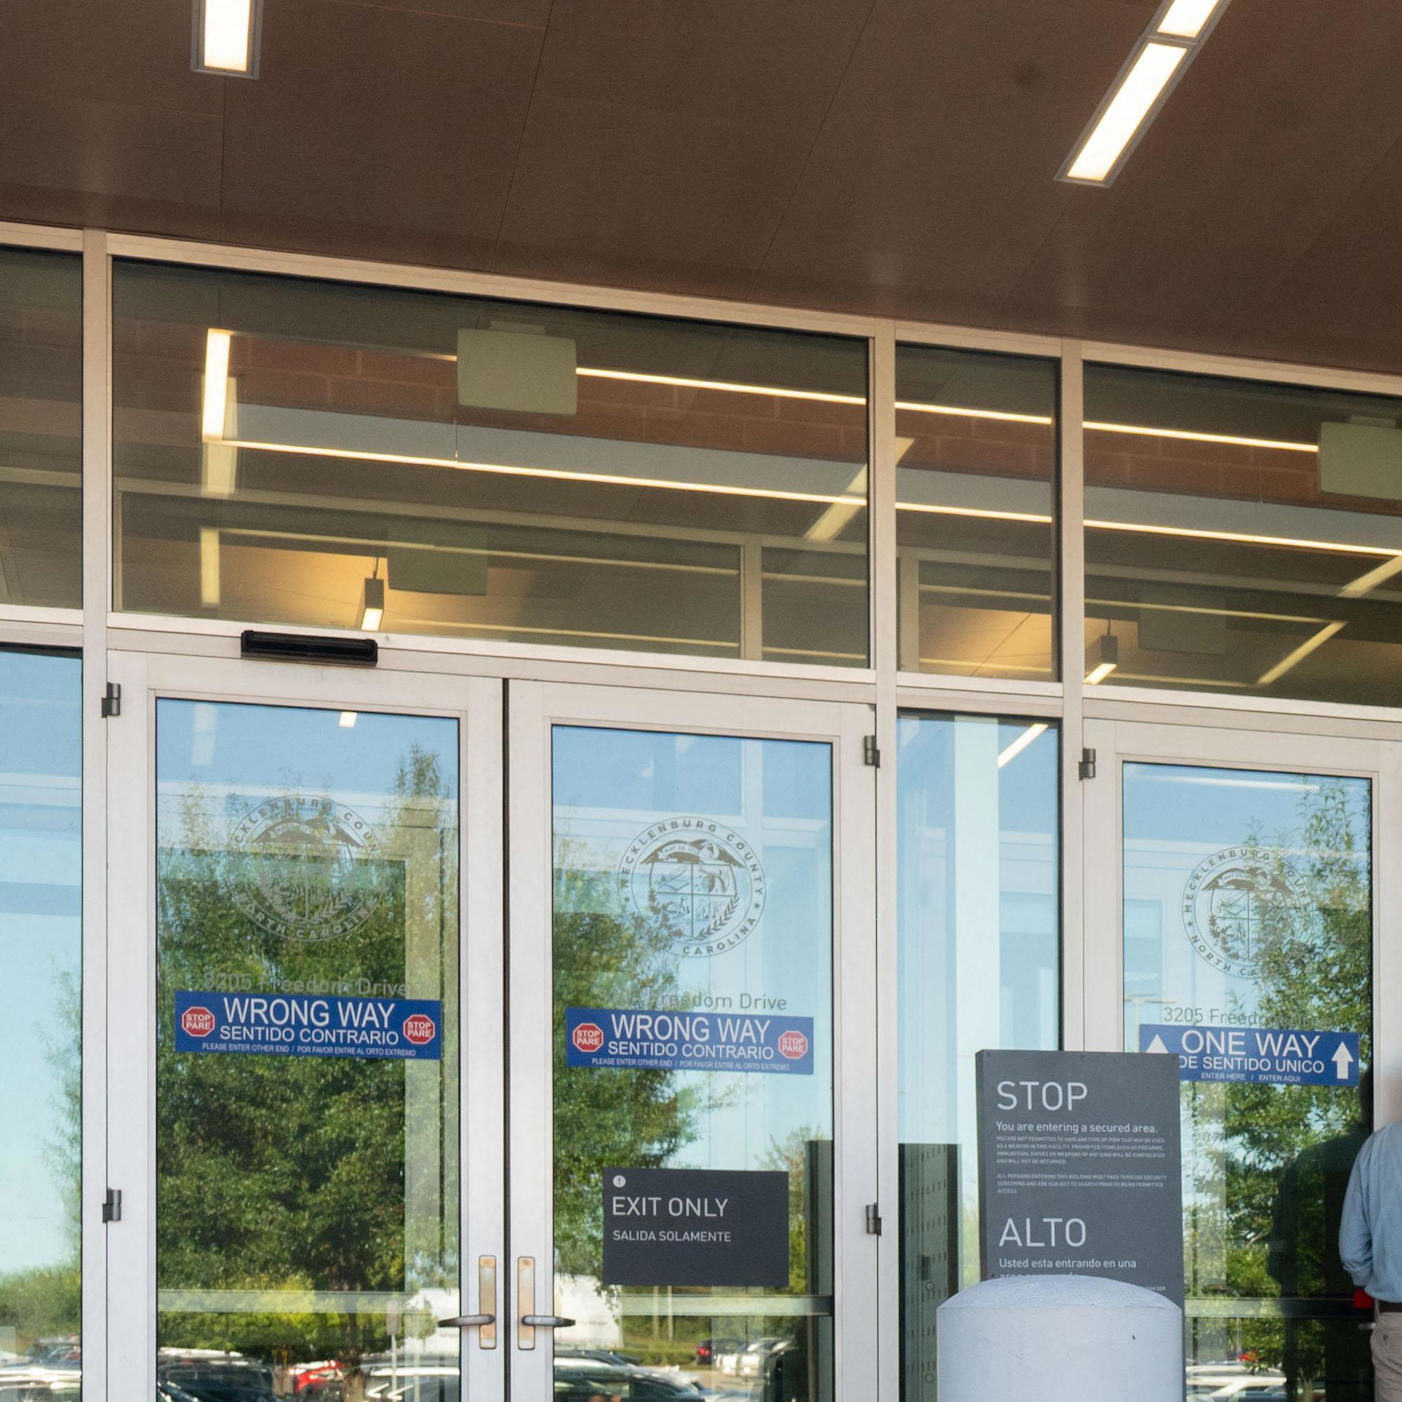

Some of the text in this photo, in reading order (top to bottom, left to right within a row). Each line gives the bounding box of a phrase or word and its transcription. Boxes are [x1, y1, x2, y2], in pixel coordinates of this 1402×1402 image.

[620, 819, 766, 896] MECKLENBURG COUNTY
[682, 916, 757, 955] CAROLINA
[1190, 934, 1232, 974] NORTH
[740, 993, 788, 1011] Drive
[186, 1013, 211, 1022] STOP
[224, 997, 396, 1029] WRONG WAY
[1163, 1006, 1204, 1023] 3205
[186, 1022, 211, 1031] PARE
[407, 1021, 431, 1030] STOP
[407, 1029, 431, 1038] PARE
[576, 1029, 600, 1038] STOP
[611, 1014, 771, 1044] WRONG WAY
[220, 1025, 399, 1047] SENTIDO CONTRARIO
[576, 1037, 600, 1046] PARE
[782, 1037, 804, 1046] STOP
[1182, 1030, 1320, 1058] ONE WAY
[202, 1042, 228, 1050] PLEASE
[229, 1043, 250, 1051] ENTER
[251, 1044, 274, 1052] OTHER
[334, 1047, 357, 1055] ENTRE
[384, 1049, 416, 1057] EXTREMO
[608, 1041, 774, 1060] SENTIDO CONTRARIO
[782, 1044, 804, 1053] PARE
[592, 1057, 615, 1066] PLEASE
[616, 1058, 637, 1067] ENTER
[1179, 1056, 1325, 1074] DE SENTIDO UNICO
[1201, 1071, 1225, 1080] ENTER
[1226, 1073, 1246, 1081] HERE
[1259, 1073, 1281, 1082] ENTER
[1282, 1075, 1301, 1083] AQUI
[997, 1081, 1088, 1111] STOP
[996, 1121, 1158, 1134] You are entering a secured area.
[612, 1196, 728, 1217] EXIT ONLY
[613, 1230, 732, 1243] SALIDA SOLAMENTE
[998, 1217, 1087, 1247] ALTO
[999, 1258, 1136, 1268] Usted esta entrando en una
